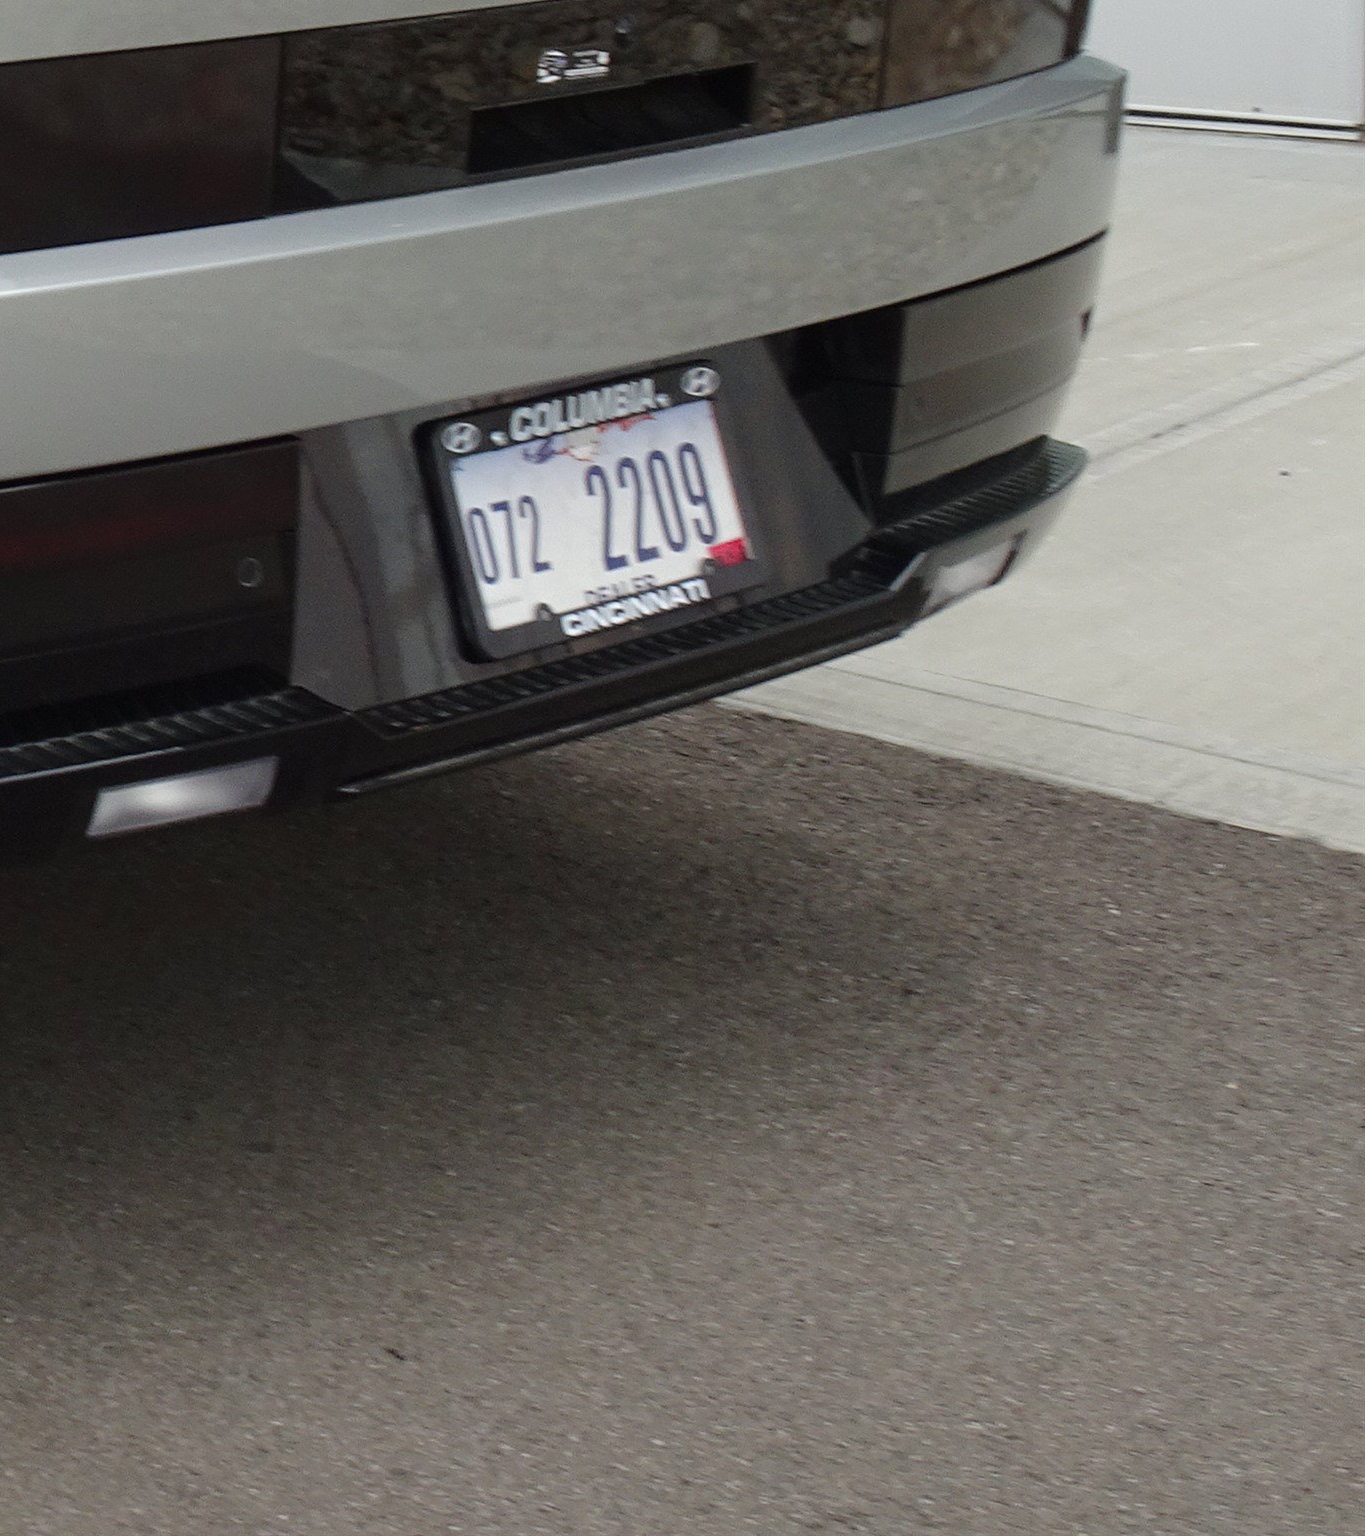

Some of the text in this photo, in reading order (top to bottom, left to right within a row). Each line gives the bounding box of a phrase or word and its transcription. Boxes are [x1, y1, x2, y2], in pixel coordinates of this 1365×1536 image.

[508, 378, 658, 442] COLUMBIA
[469, 442, 718, 585] 072 2209
[559, 578, 711, 637] CINCINNATI
